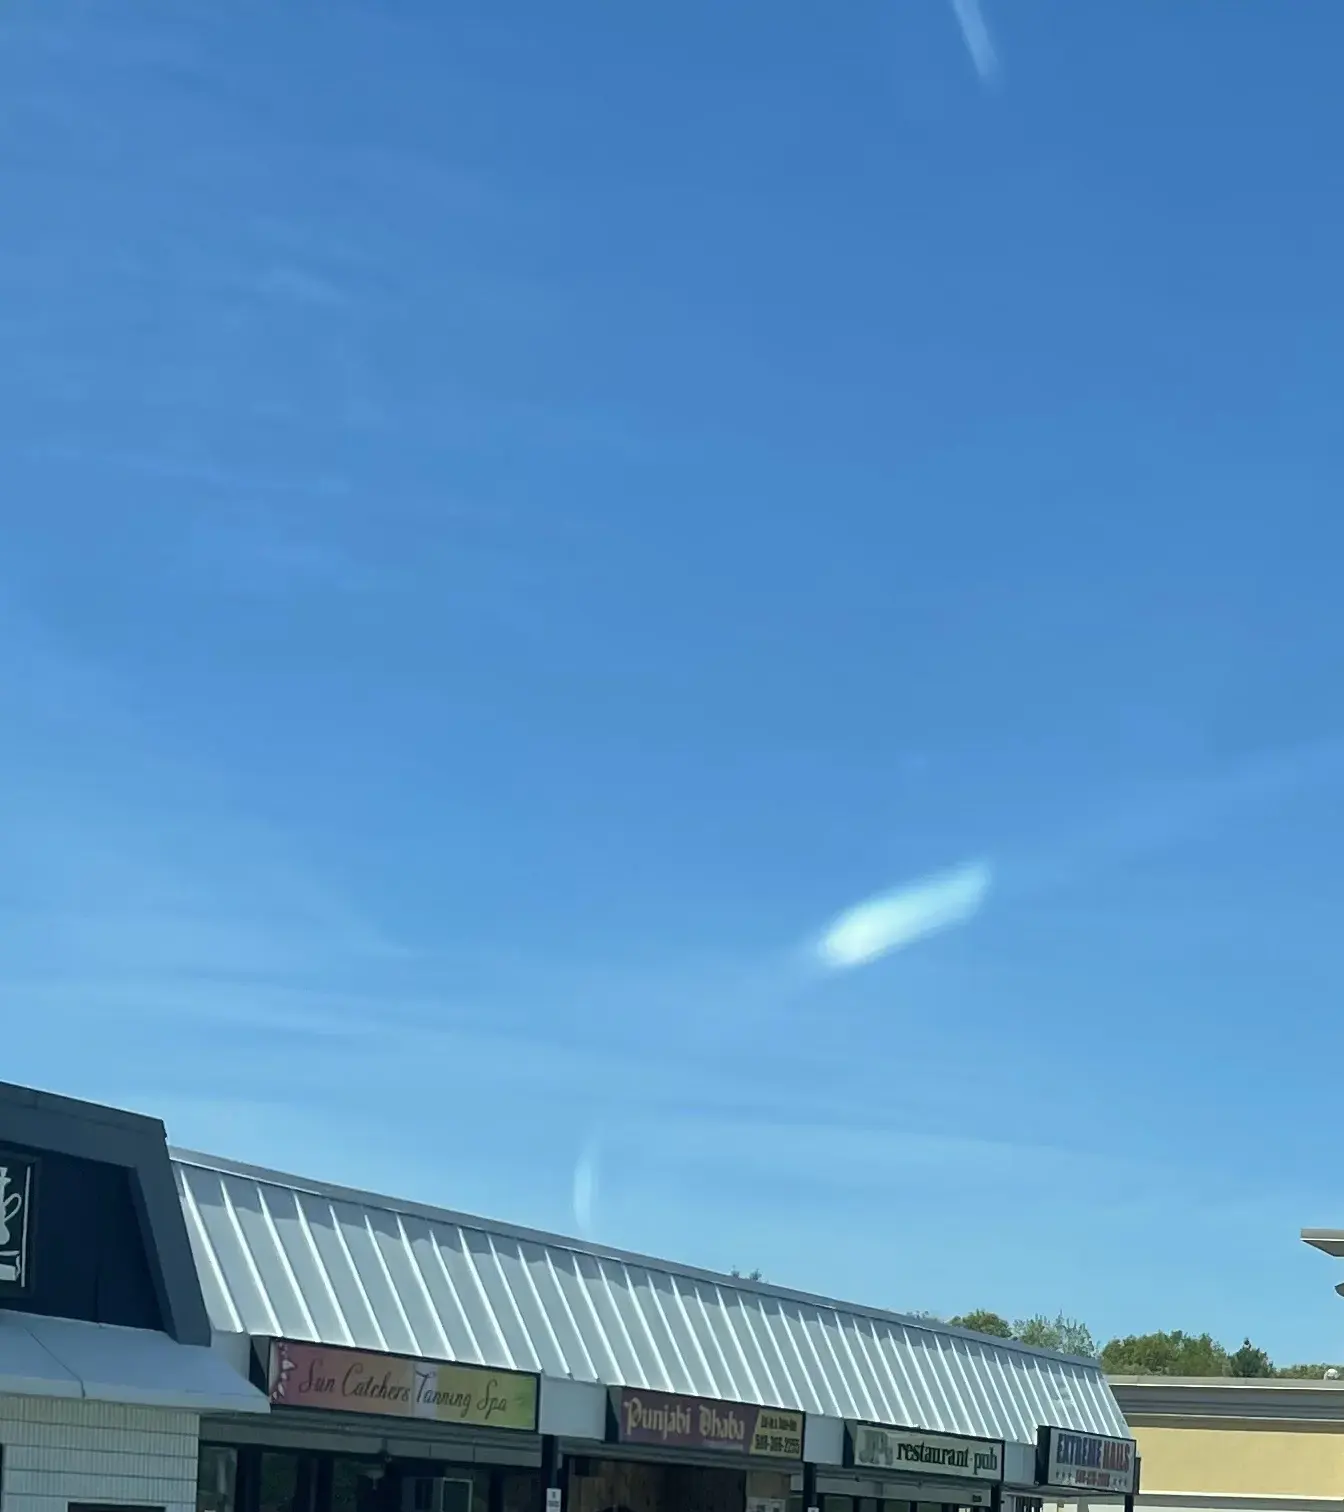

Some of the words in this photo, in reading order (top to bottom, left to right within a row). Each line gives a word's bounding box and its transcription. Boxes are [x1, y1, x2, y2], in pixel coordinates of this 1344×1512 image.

[299, 1358, 335, 1394] Sun
[341, 1362, 410, 1401] Catchers
[413, 1364, 472, 1418] Tanning
[476, 1379, 507, 1419] Spa
[624, 1397, 692, 1440] Punjabi
[699, 1404, 744, 1440] Dhaba
[897, 1441, 969, 1467] restaurant
[973, 1447, 998, 1475] pub
[1057, 1433, 1102, 1469] EXTREME
[1102, 1440, 1130, 1472] NAILS
